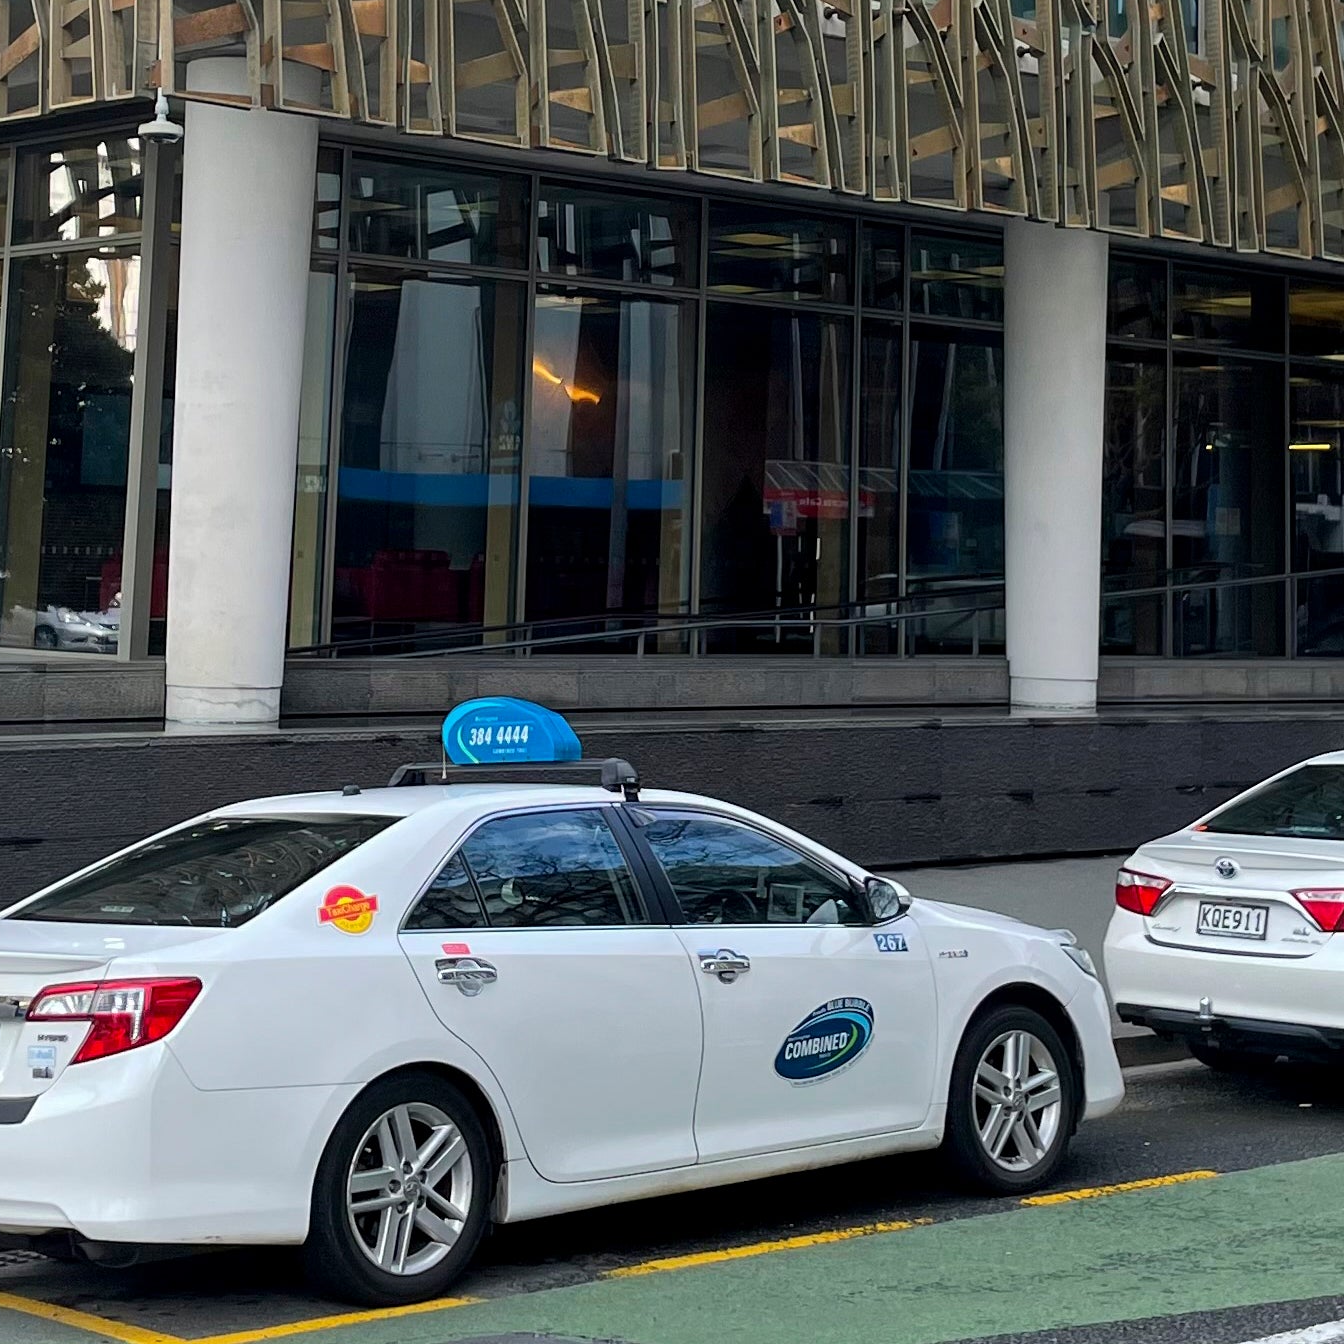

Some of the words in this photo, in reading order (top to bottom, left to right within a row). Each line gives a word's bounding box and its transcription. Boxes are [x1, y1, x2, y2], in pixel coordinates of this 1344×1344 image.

[469, 726, 492, 746] 384
[496, 725, 529, 745] 4444
[1201, 908, 1262, 932] KQE911
[877, 935, 905, 951] 267
[784, 1032, 848, 1061] COMBINED
